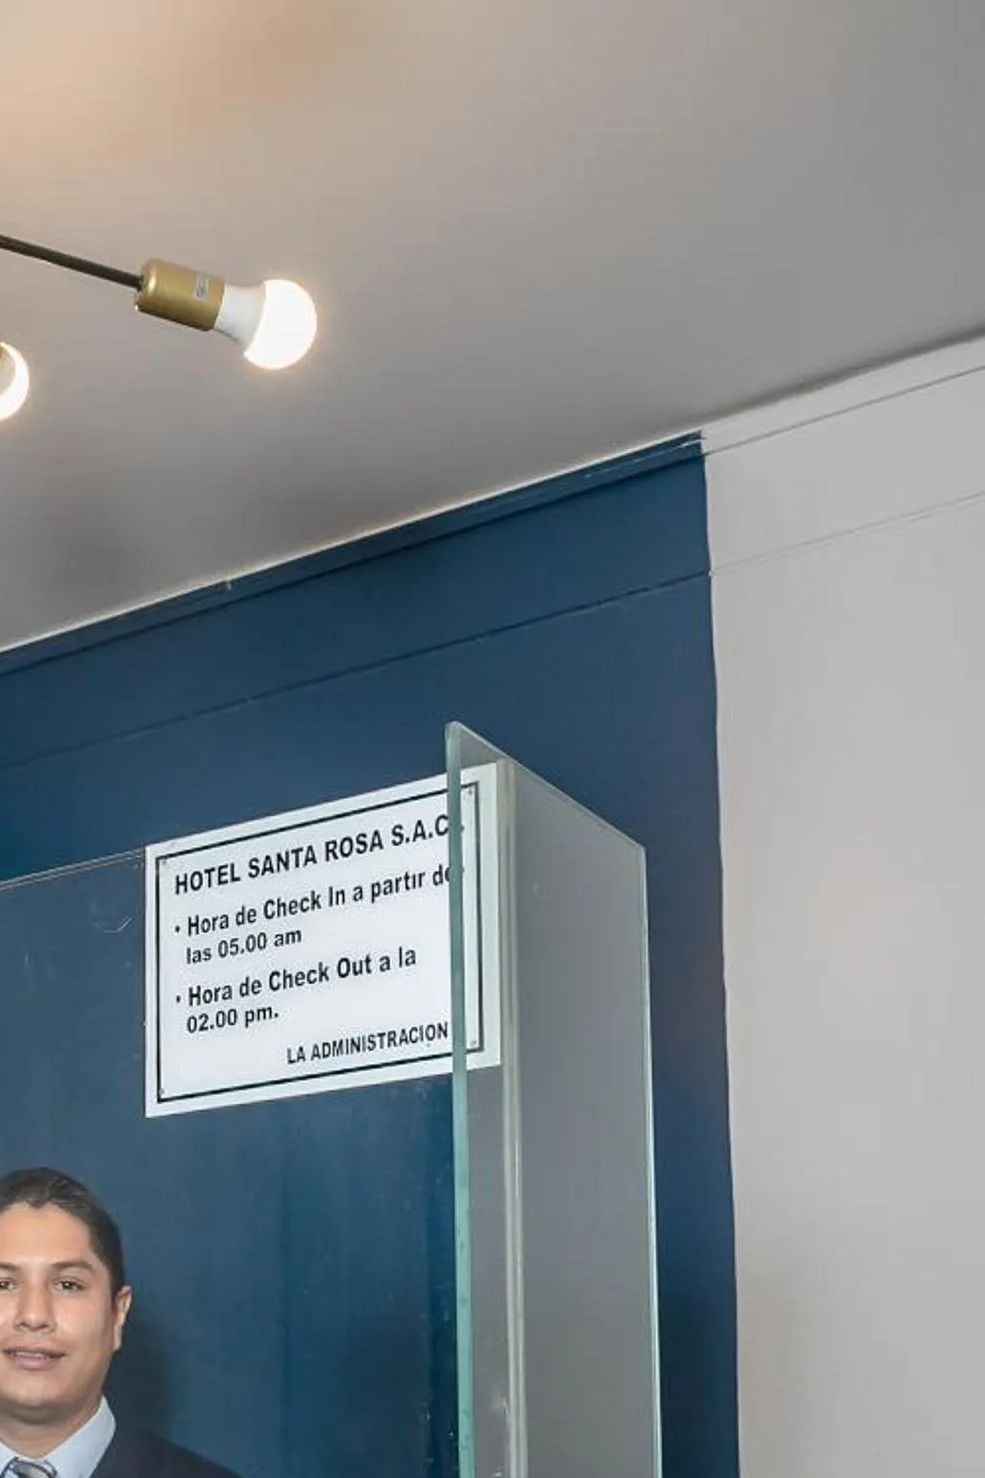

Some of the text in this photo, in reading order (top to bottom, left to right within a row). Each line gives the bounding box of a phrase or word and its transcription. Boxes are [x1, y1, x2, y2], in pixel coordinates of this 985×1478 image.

[175, 864, 241, 895] HOTEL
[248, 845, 317, 879] SANTA
[324, 829, 384, 863] ROSA
[187, 912, 229, 937] Hora
[235, 905, 257, 927] de
[263, 891, 322, 921] Check
[328, 886, 346, 907] In
[352, 884, 365, 901] a
[370, 868, 426, 902] partir
[186, 928, 303, 964] las 05.00 am
[187, 947, 417, 1007] Hora de Check Out a la
[186, 1004, 280, 1034] 02.00 pm.
[286, 1021, 449, 1064] LA ADMINISTRACION
